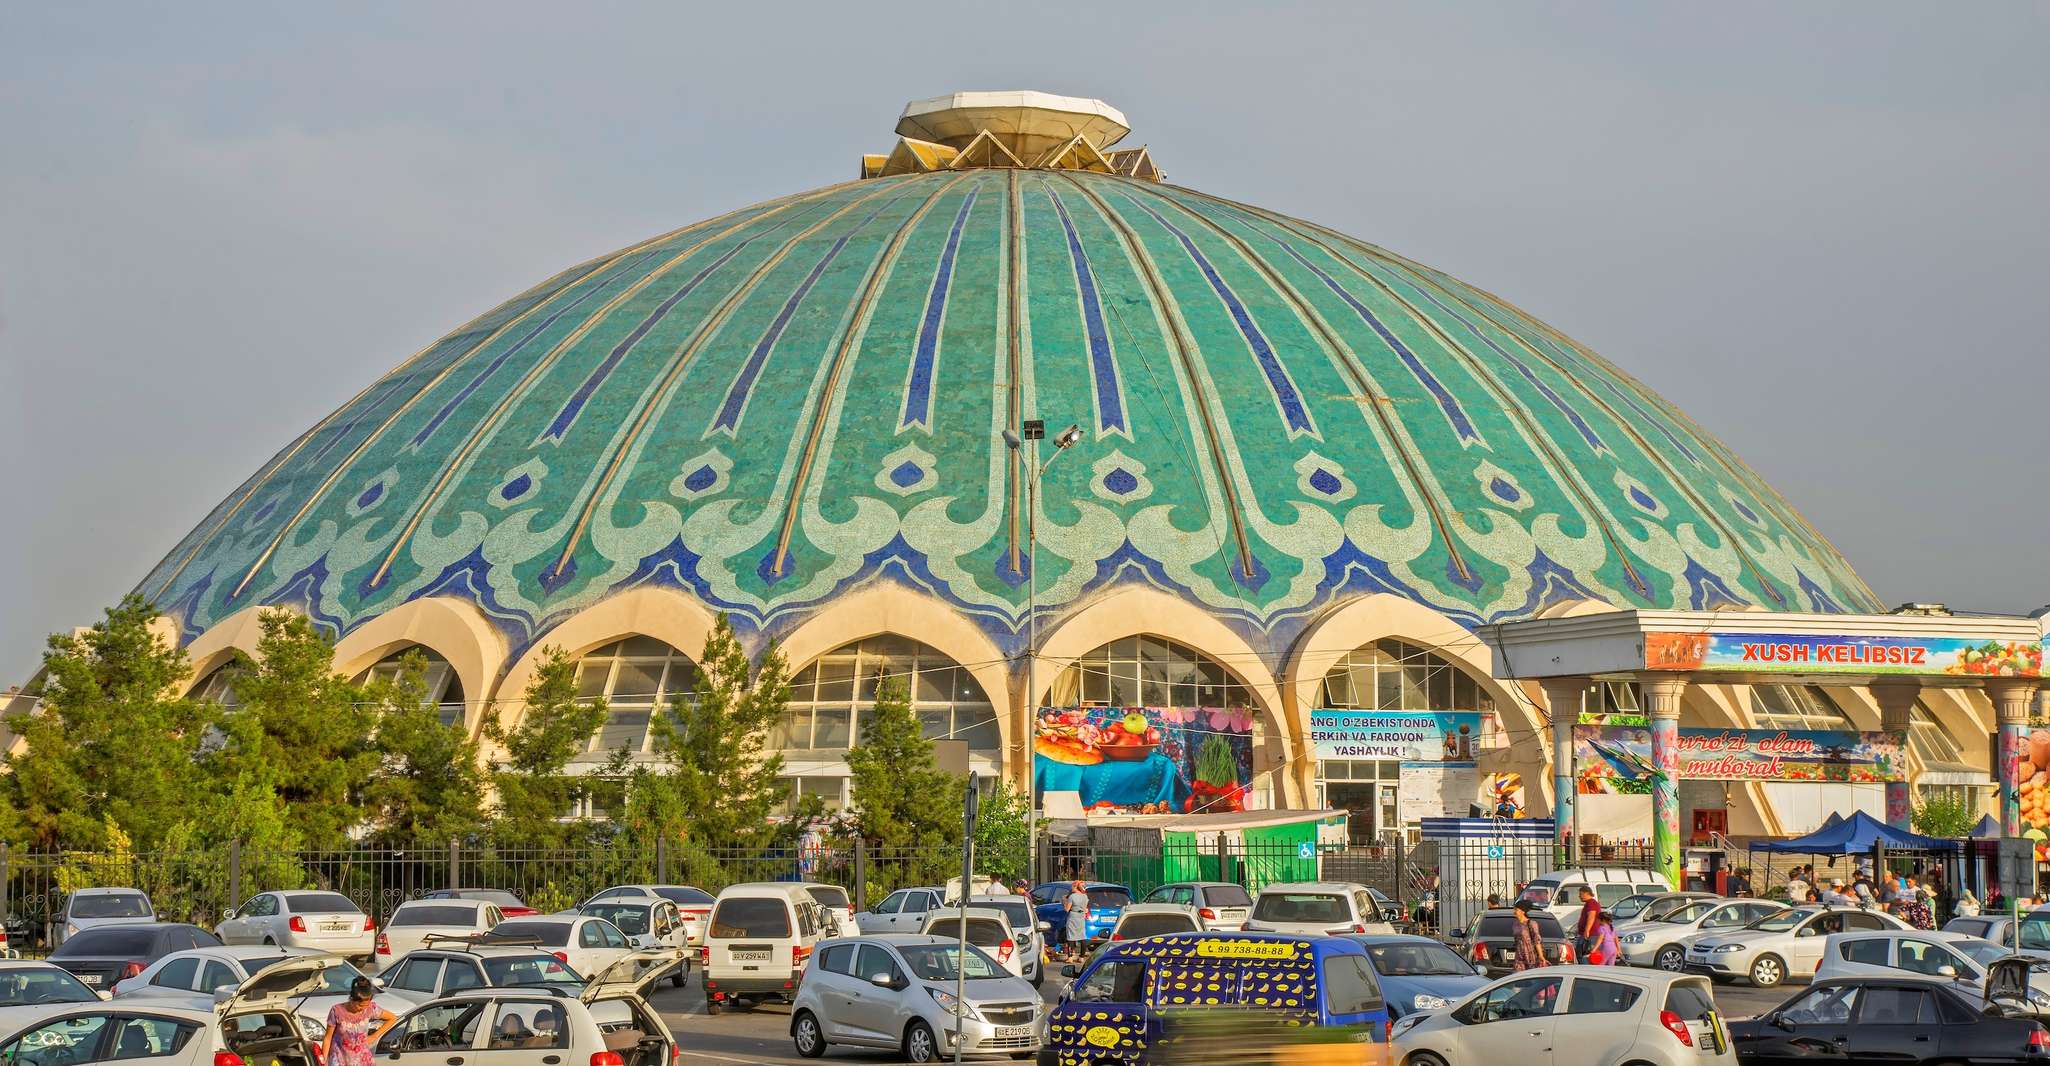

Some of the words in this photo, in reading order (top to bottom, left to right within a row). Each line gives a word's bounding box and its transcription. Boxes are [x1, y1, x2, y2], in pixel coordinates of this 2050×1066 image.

[1743, 643, 1809, 662] XUSH
[1817, 644, 1926, 665] KELIBSIZ
[1351, 732, 1367, 741] VA
[1370, 732, 1424, 742] FAROVON
[1758, 731, 1816, 753] olam
[1334, 746, 1399, 756] YASHAYLIK
[1686, 754, 1786, 777] muborak
[1217, 945, 1230, 953] 99
[1233, 946, 1284, 955] 738-88-88
